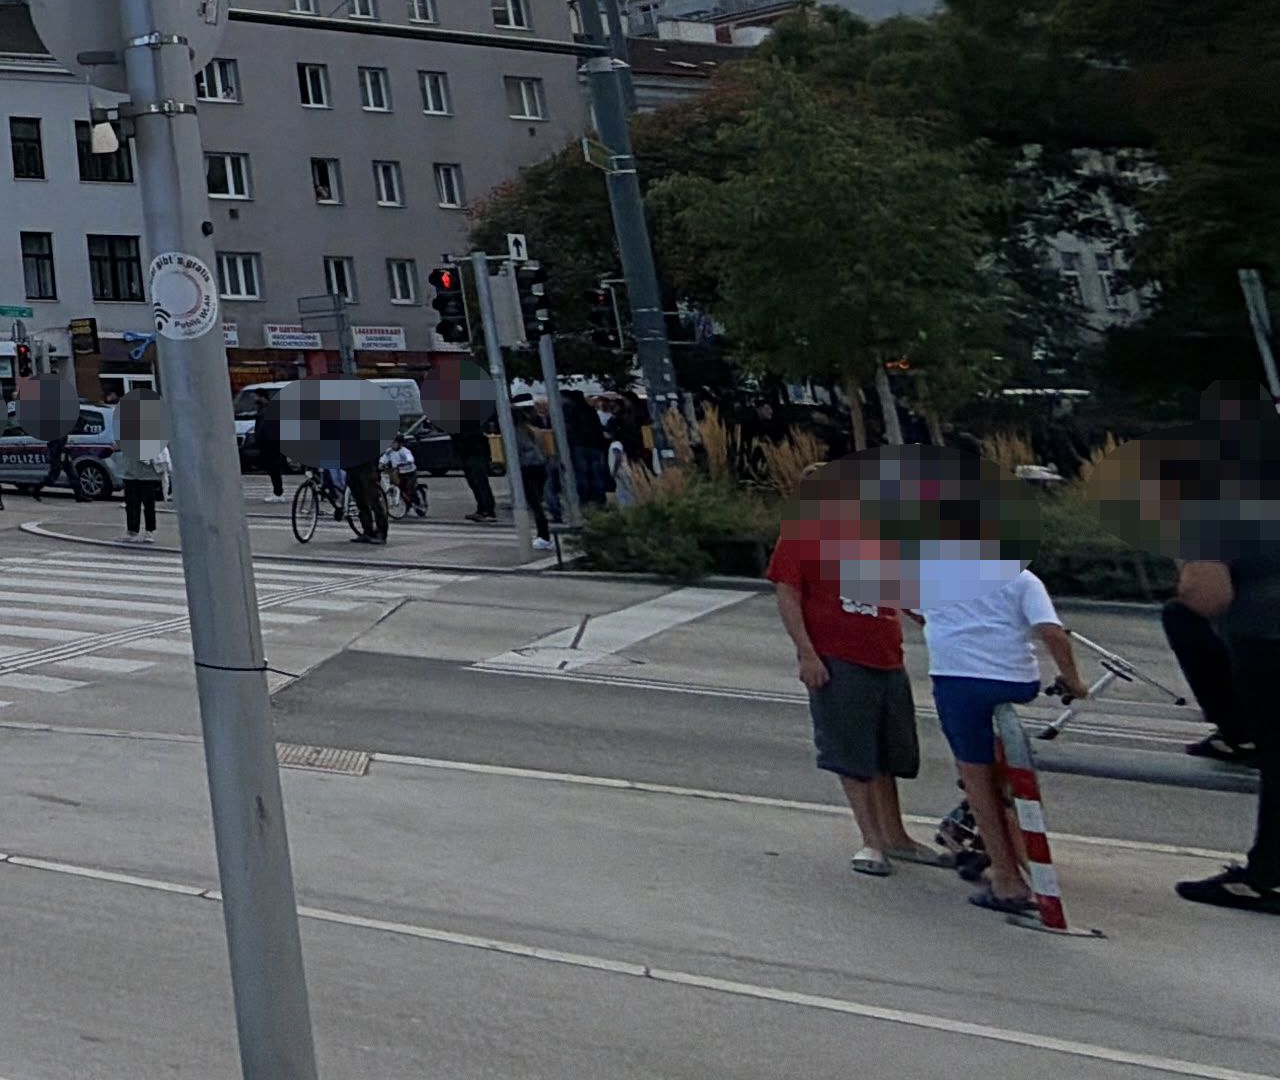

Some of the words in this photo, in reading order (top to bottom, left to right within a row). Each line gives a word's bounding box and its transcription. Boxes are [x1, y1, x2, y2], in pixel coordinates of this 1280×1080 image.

[186, 259, 210, 282] gratis
[174, 318, 202, 329] Public
[2, 454, 46, 464] POLIZEI
